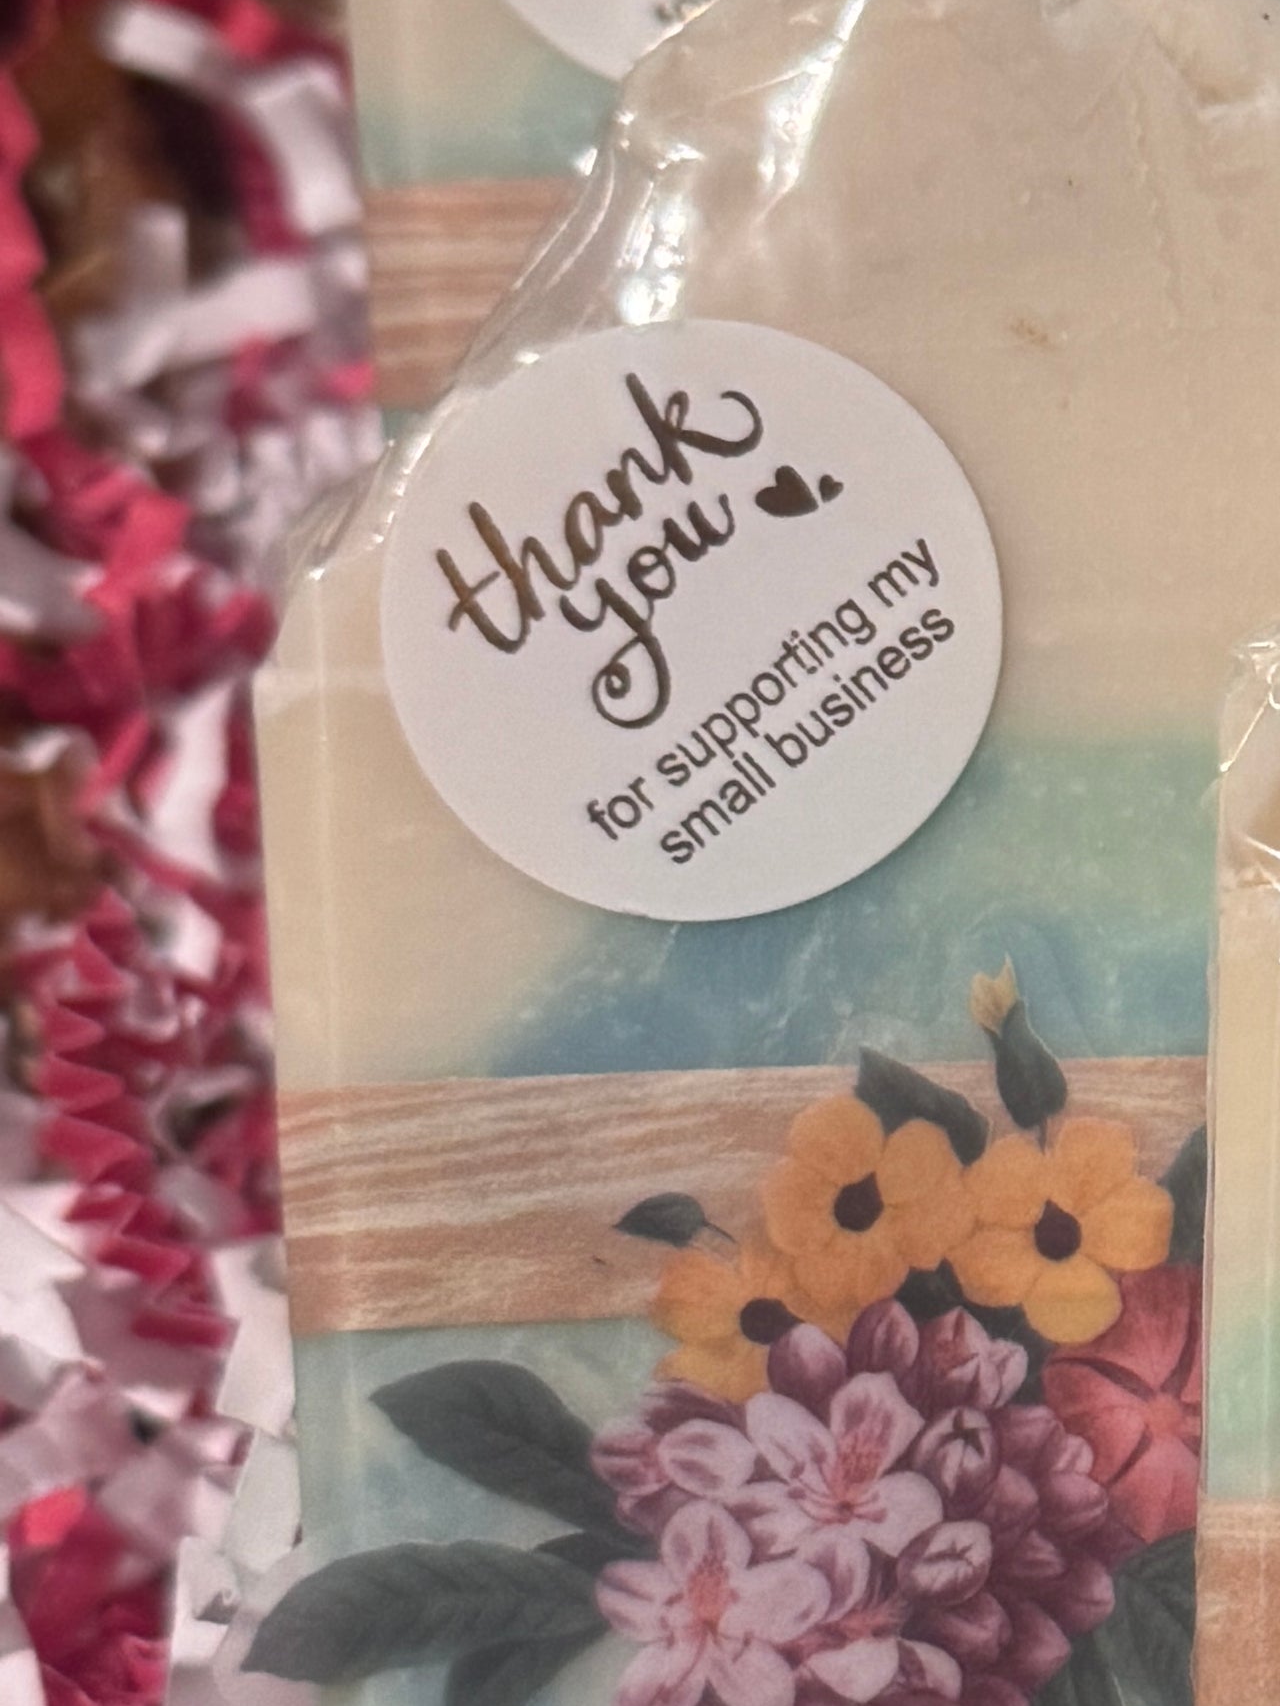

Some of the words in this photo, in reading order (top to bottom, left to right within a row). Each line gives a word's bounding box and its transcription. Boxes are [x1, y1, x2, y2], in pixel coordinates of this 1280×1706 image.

[436, 373, 763, 653] thank
[559, 494, 735, 729] you
[587, 776, 654, 840] for
[656, 599, 877, 786] supporting
[867, 538, 941, 607] my
[660, 753, 776, 864] small
[764, 607, 956, 768] business
